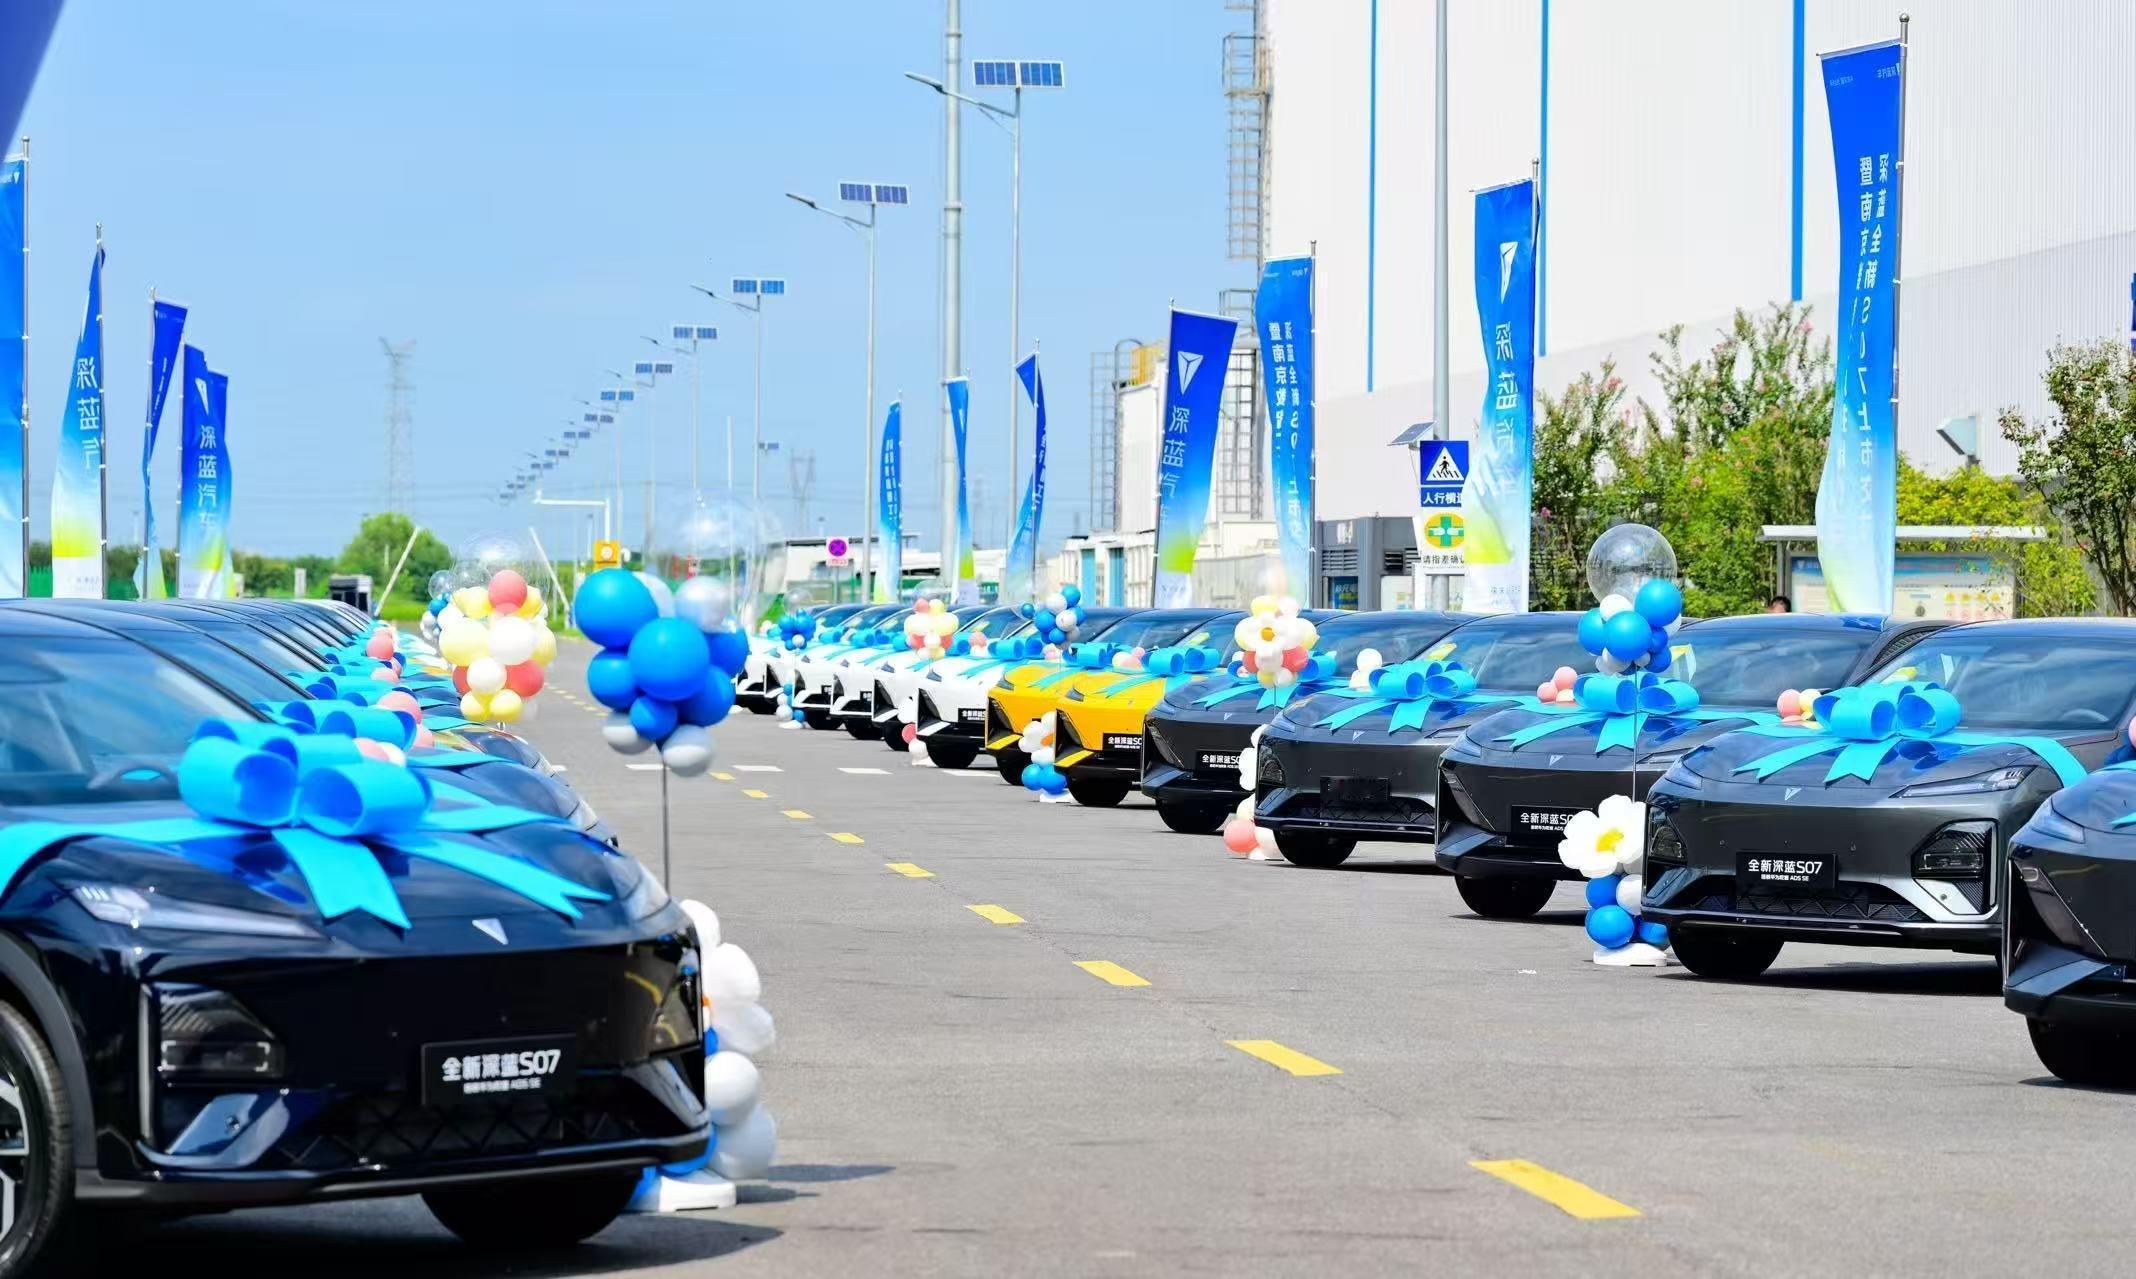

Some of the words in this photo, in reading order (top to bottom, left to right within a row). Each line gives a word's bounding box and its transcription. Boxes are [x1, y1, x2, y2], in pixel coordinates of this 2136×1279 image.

[1520, 812, 1574, 825] 全新深蓝S
[1748, 859, 1823, 874] 全新深蓝S07
[442, 1049, 561, 1081] 全新深蓝S07
